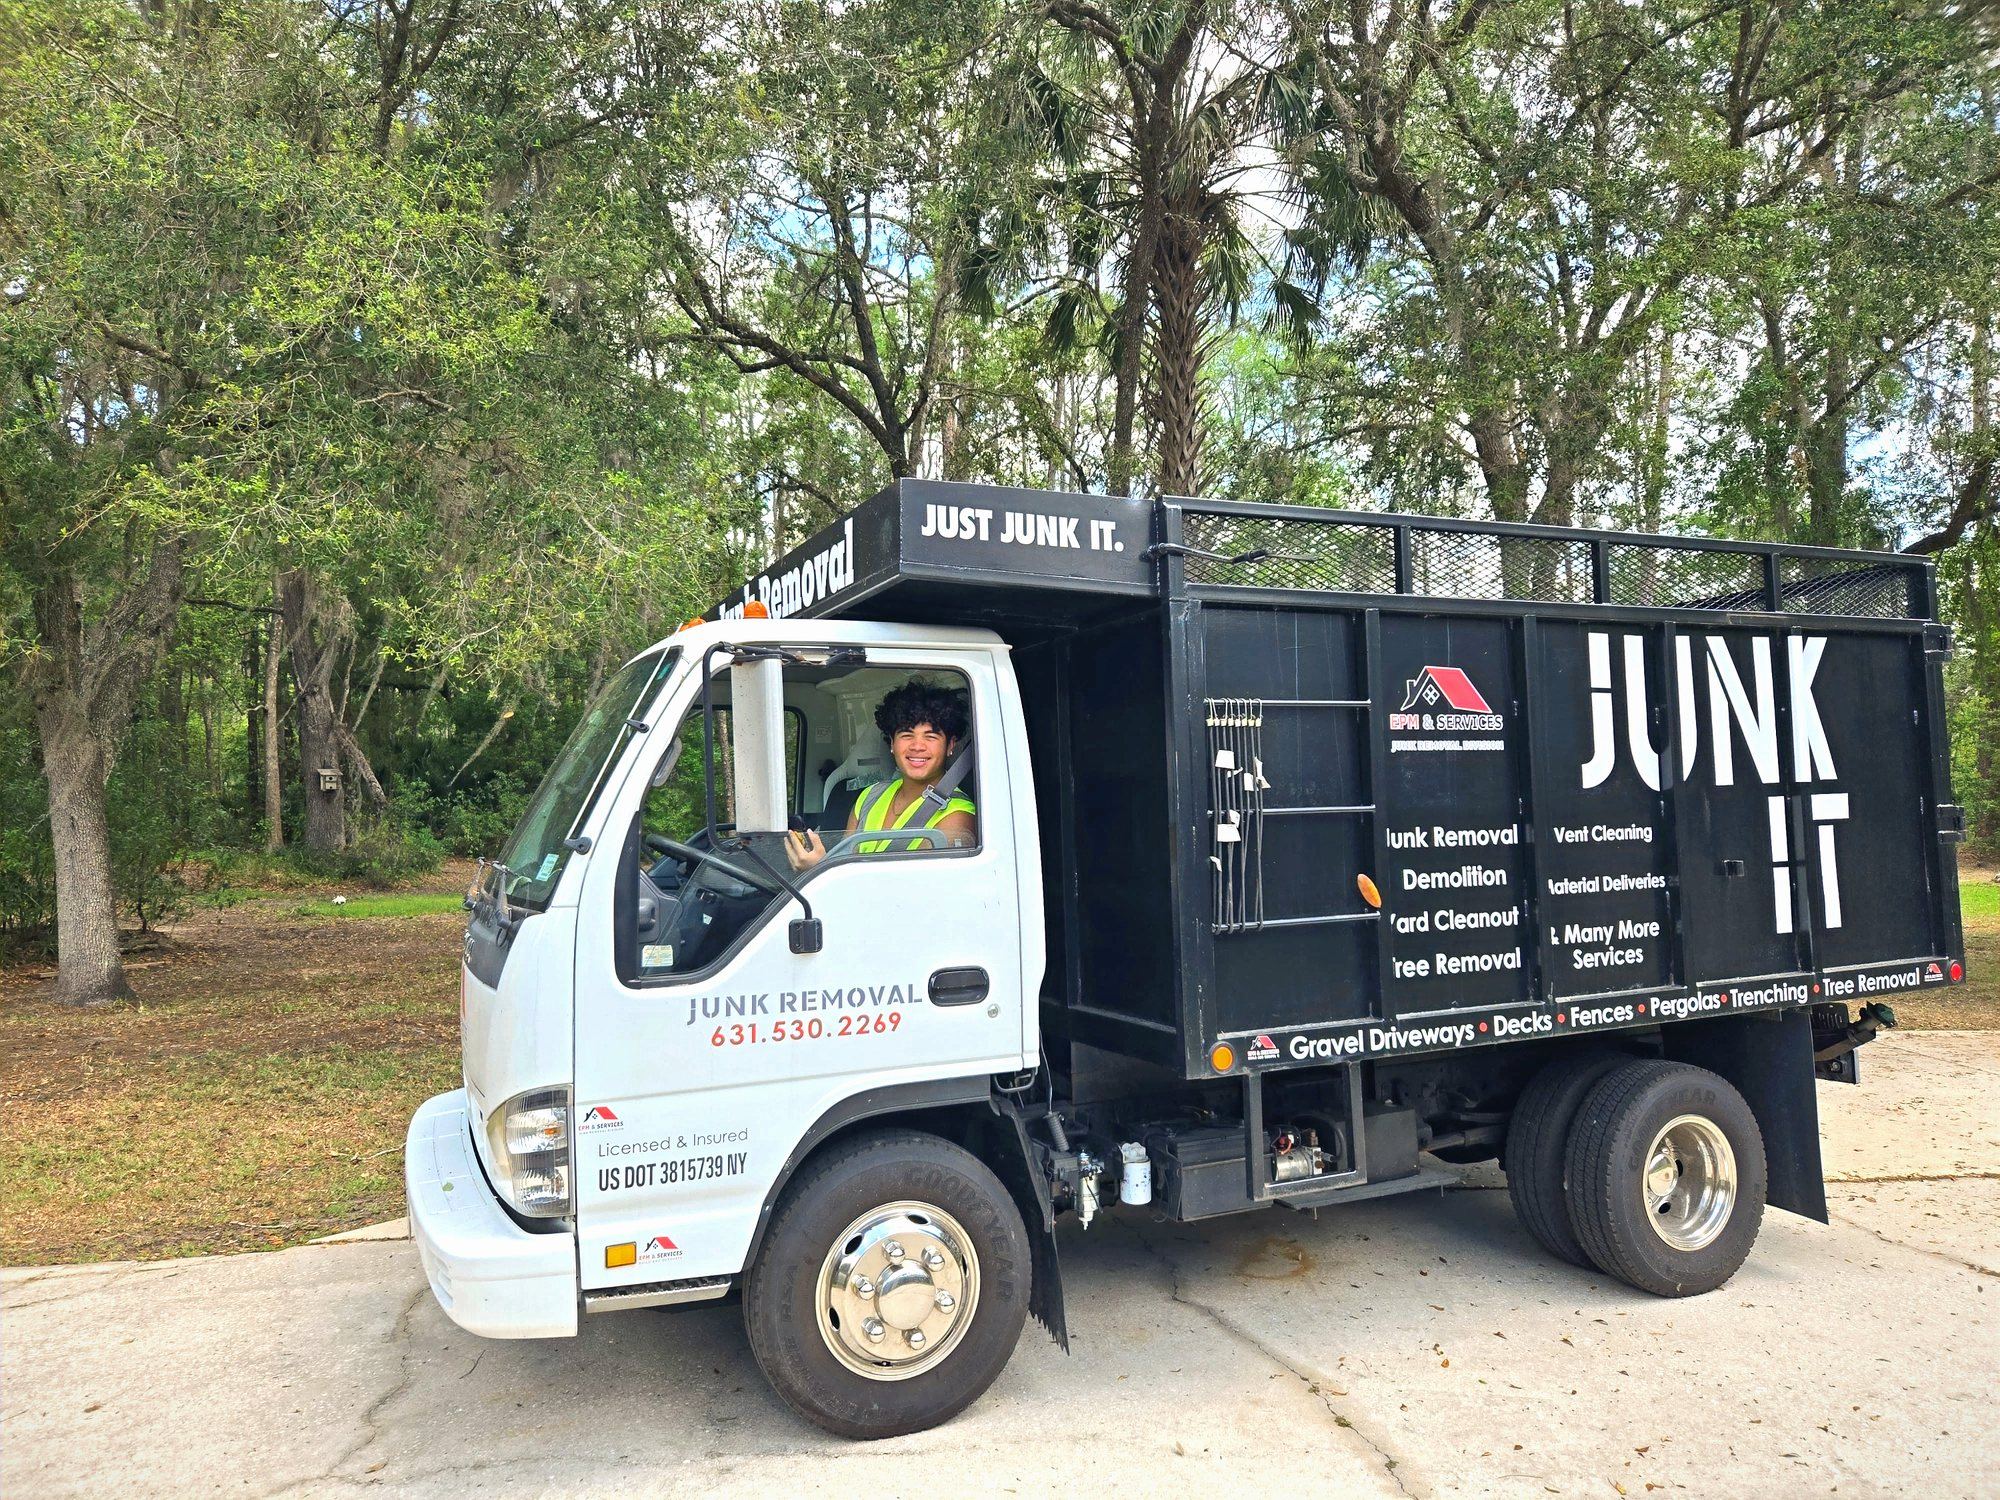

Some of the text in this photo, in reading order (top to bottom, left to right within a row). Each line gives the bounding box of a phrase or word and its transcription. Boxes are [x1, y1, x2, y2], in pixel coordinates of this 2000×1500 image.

[921, 504, 1125, 553] JUST JUNK IT.
[758, 517, 855, 619] Removal
[1390, 714, 1504, 731] EPM & SERVICES
[1580, 632, 1838, 792] JUNK
[1433, 824, 1519, 848] Removal
[1554, 823, 1653, 843] Vent Cleaning
[1767, 792, 1849, 934] IT
[1402, 865, 1507, 890] Demolition
[1602, 873, 1665, 892] Deliveries
[1390, 906, 1519, 934] ard Cleanout
[1564, 923, 1614, 946] Many
[1618, 919, 1660, 940] More
[1392, 947, 1521, 979] ree Removal
[1572, 946, 1644, 970] Services
[687, 984, 923, 1026] JUNK REMOVAL
[1289, 1029, 1365, 1060] Gravel
[1370, 1022, 1475, 1051] Driveways
[1493, 1010, 1553, 1037] Decks
[1570, 1005, 1634, 1028] Fences
[1650, 993, 1721, 1020] Pergolas
[1730, 983, 1808, 1008] Trenching
[1822, 976, 1854, 996] Tree
[1858, 967, 1920, 992] Removal
[711, 1011, 901, 1047] 631.530.2269
[596, 1120, 624, 1130] SERVICES
[598, 1128, 748, 1157] Licensed & Insured
[599, 1152, 747, 1191] US DOT 3815739 NY
[656, 1250, 683, 1259] SERVICES
